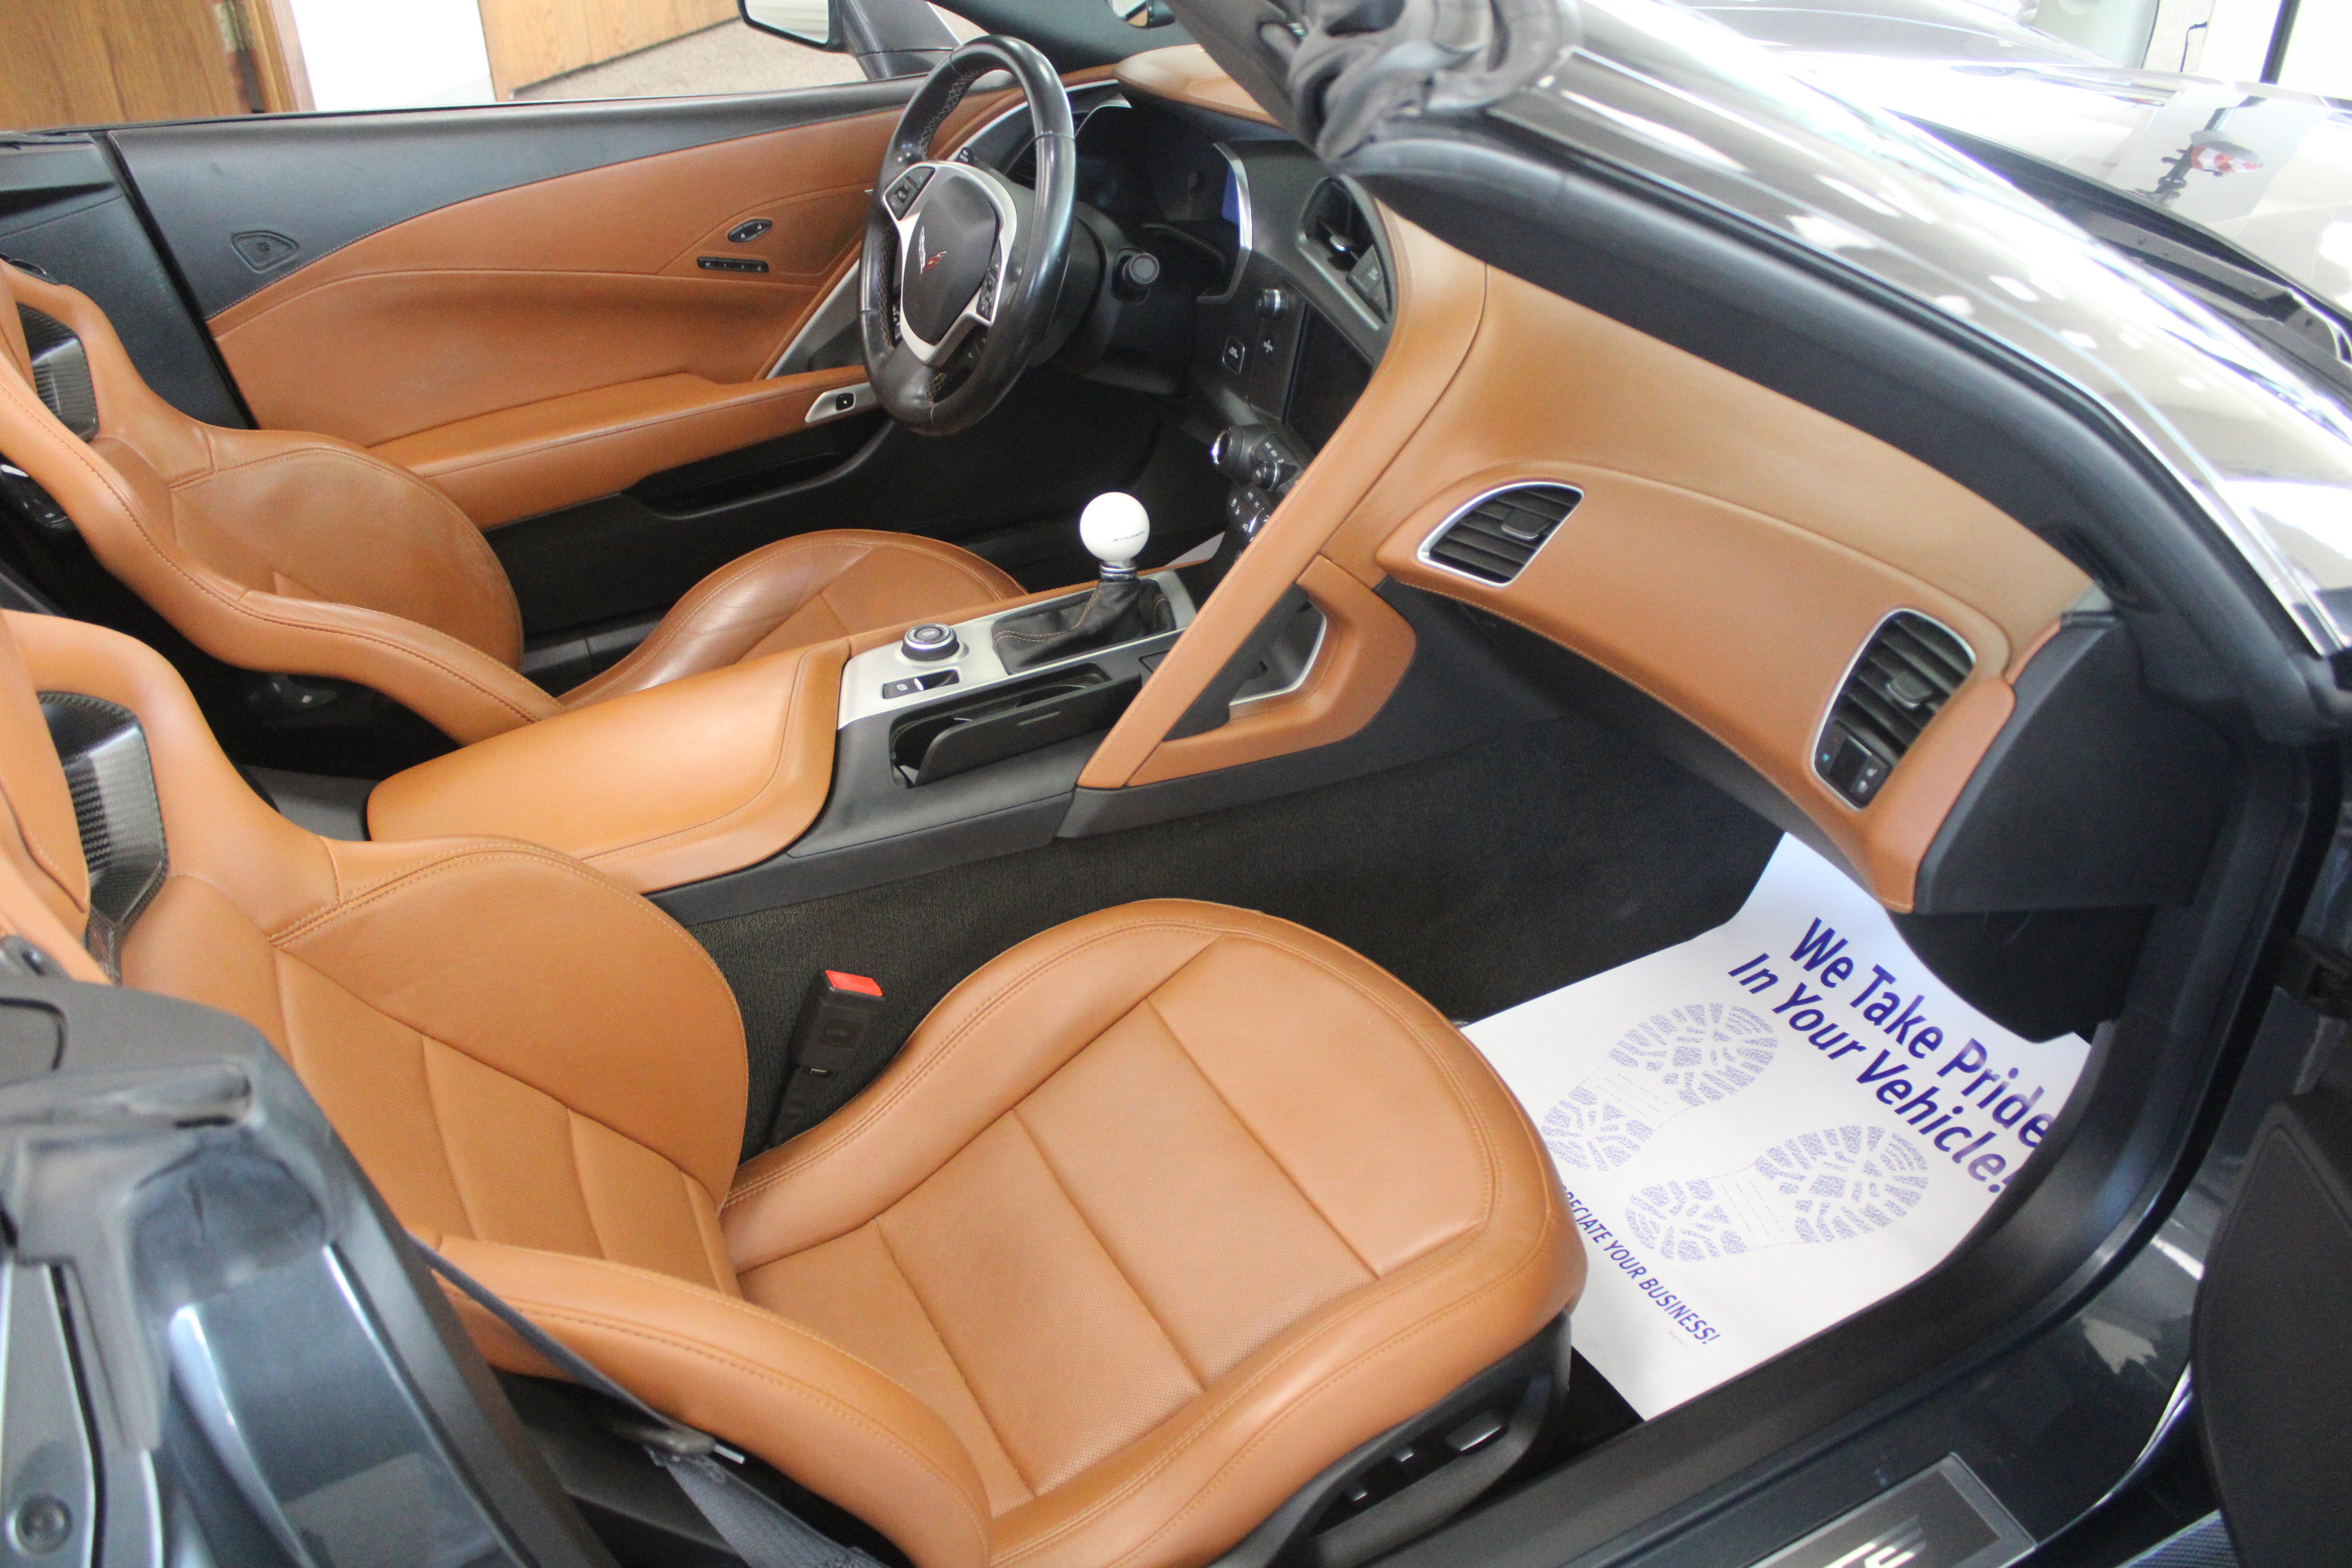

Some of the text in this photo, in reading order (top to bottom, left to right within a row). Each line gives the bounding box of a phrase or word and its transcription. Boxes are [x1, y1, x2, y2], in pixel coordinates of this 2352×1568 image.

[1728, 953, 1779, 994] In
[1772, 982, 1867, 1060] Your
[1790, 917, 2056, 1148] We Take Pride
[1604, 1240, 1647, 1279] YOUR
[1638, 1278, 1721, 1345] BUSINESS!
